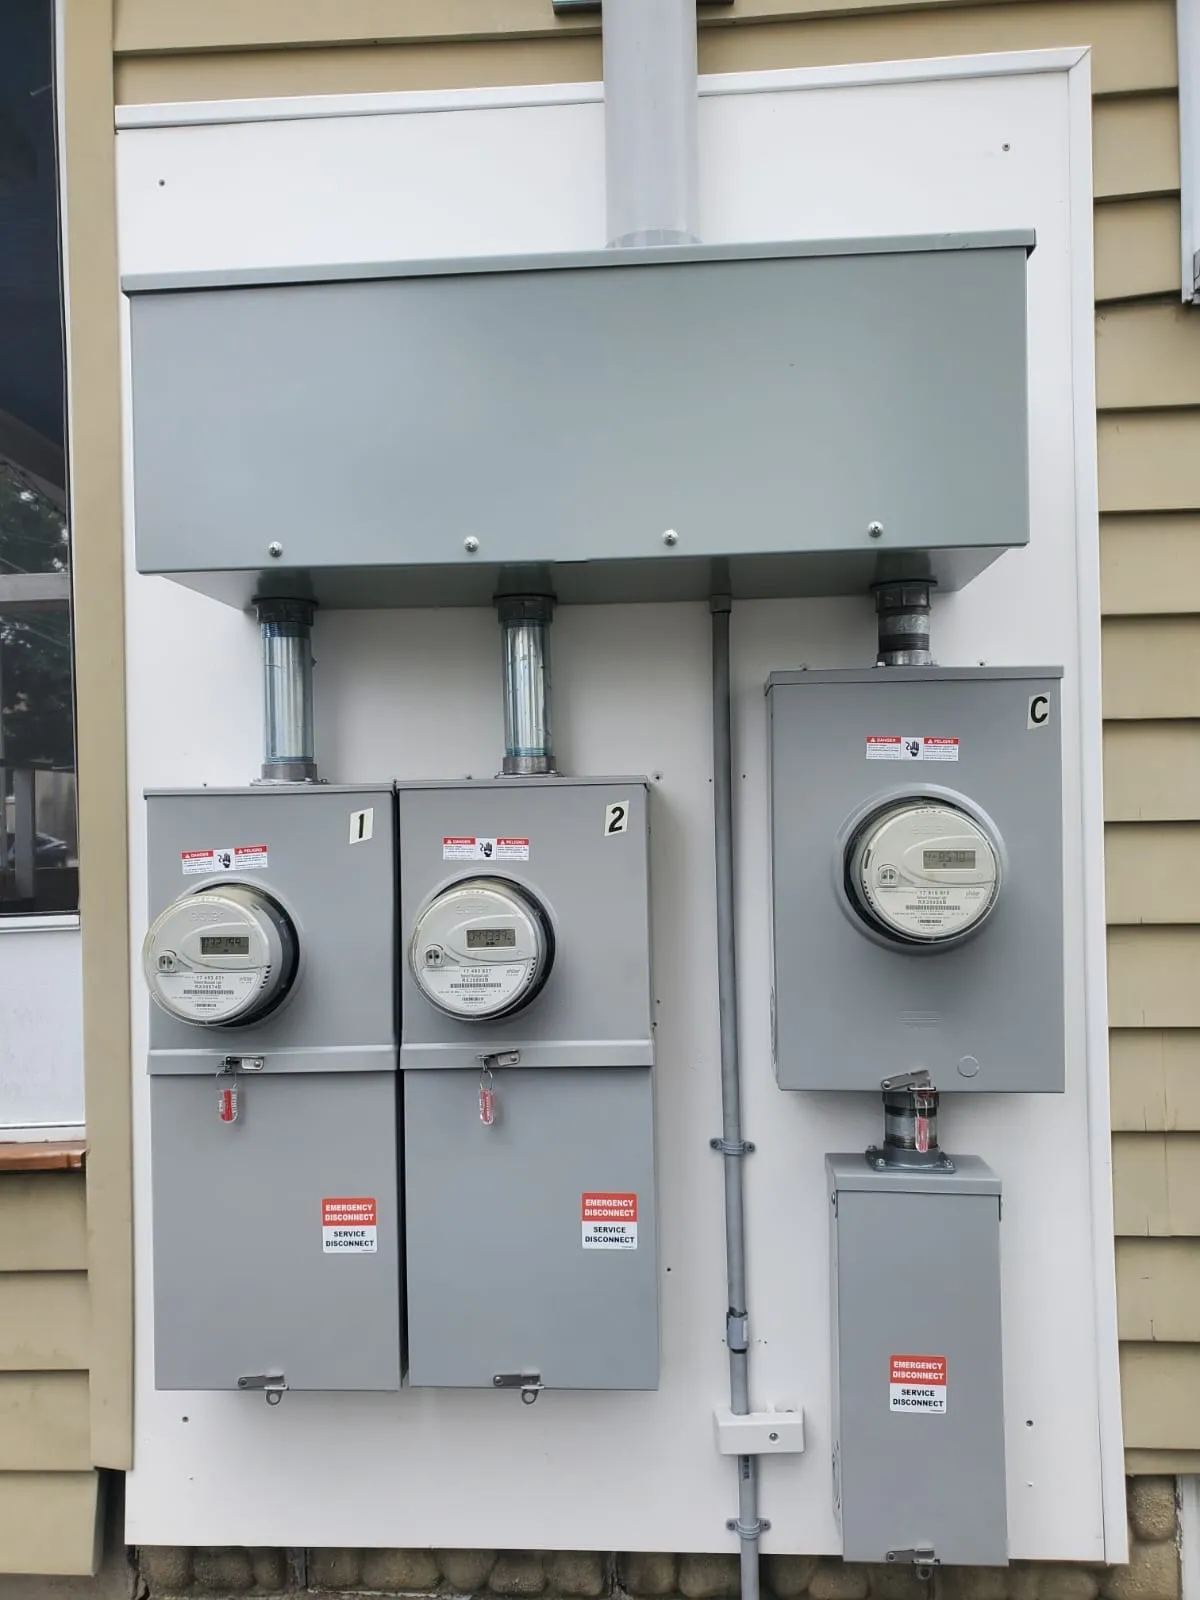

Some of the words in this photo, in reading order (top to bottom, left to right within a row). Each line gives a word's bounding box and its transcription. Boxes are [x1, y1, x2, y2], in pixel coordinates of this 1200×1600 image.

[1030, 696, 1048, 723] C
[608, 806, 624, 832] 2
[359, 813, 365, 839] 1
[585, 1199, 633, 1207] EMERGENCY
[325, 1204, 373, 1212] EMERGENCY
[325, 1213, 374, 1221] DISCONNECT
[584, 1209, 634, 1217] DISCONNECT
[893, 1361, 943, 1370] EMERGENCY
[892, 1370, 944, 1380] DISCONNECT
[901, 1388, 935, 1397] SERVICE
[892, 1398, 944, 1407] DISCONNECT
